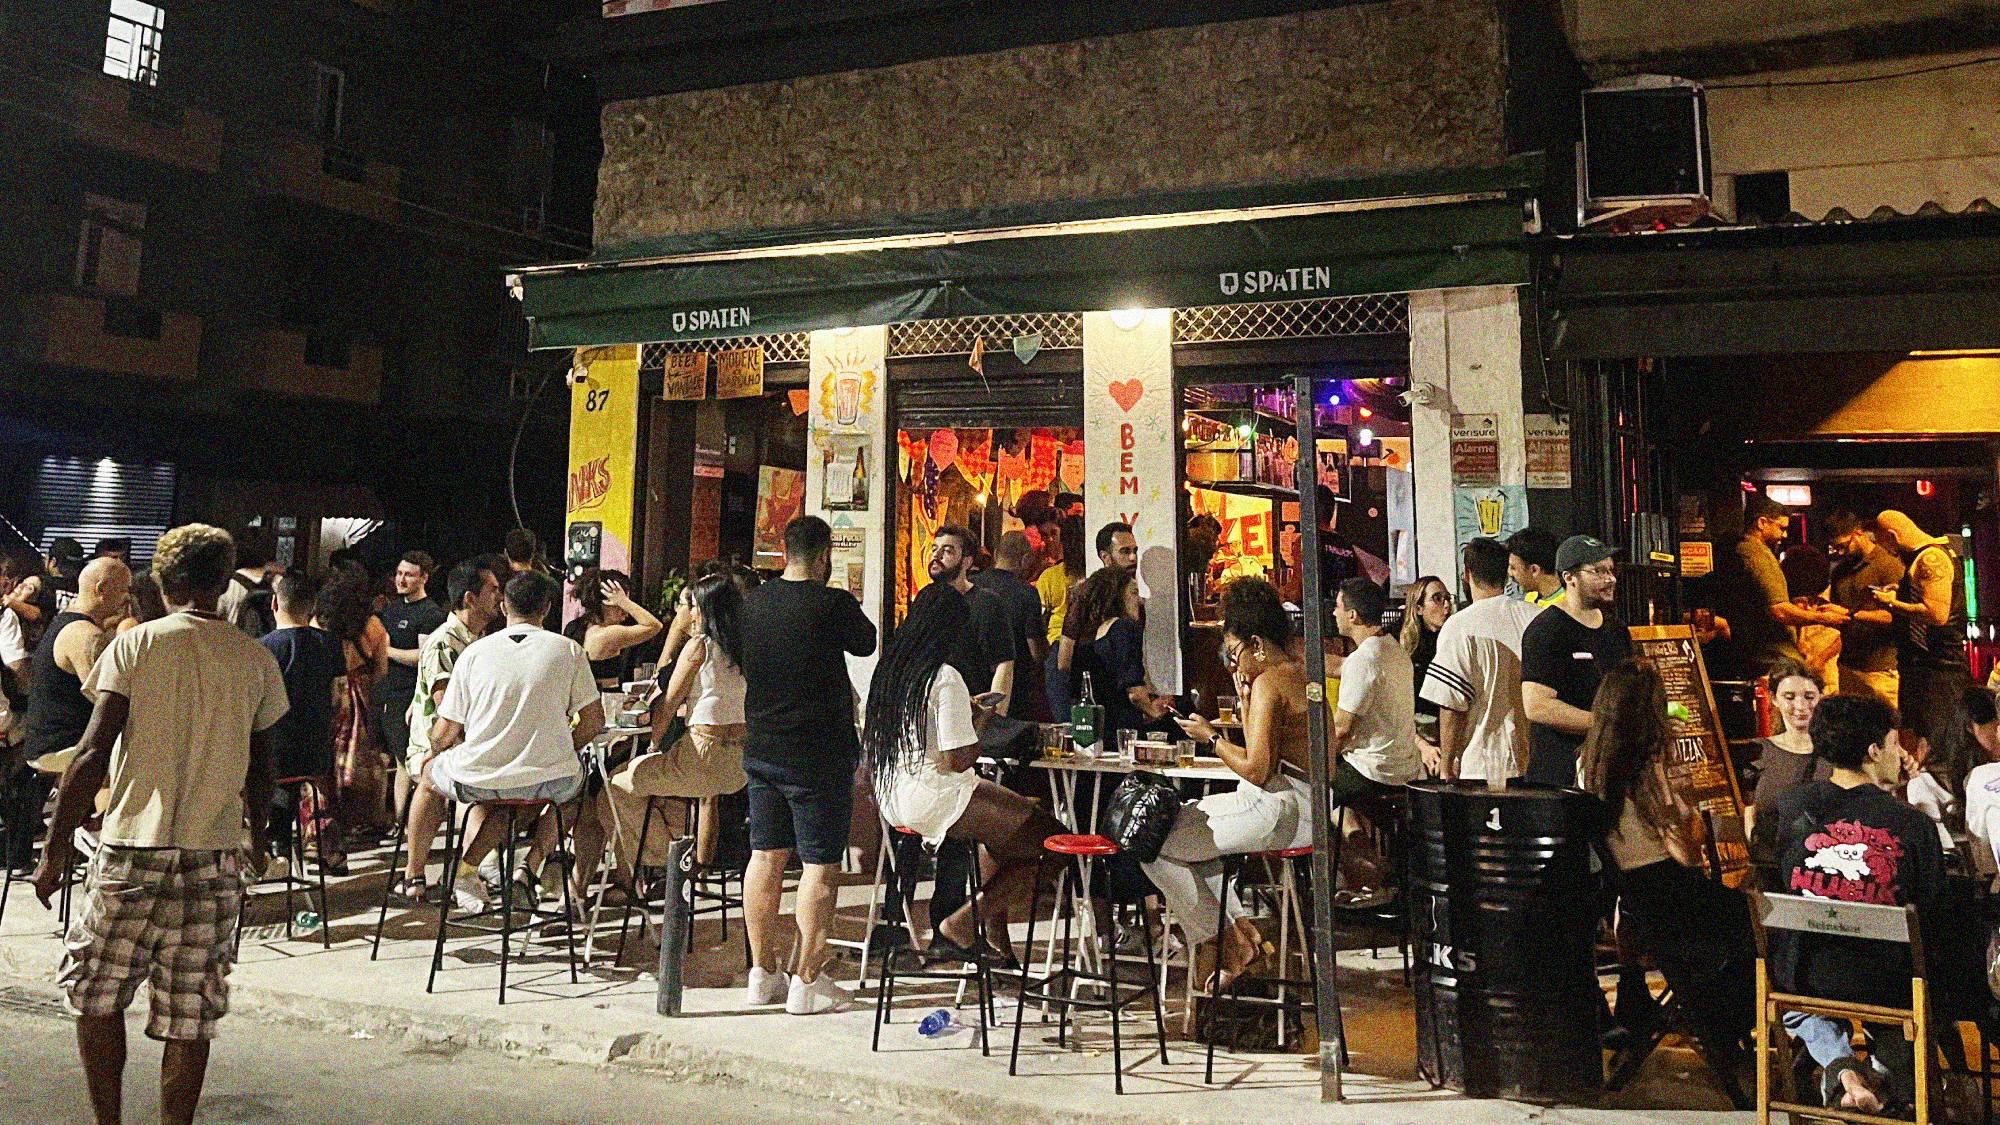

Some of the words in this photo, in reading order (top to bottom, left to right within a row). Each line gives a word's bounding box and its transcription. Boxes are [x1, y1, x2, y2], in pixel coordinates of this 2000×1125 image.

[1243, 266, 1330, 294] SPATEN
[689, 306, 750, 331] SPATEN
[586, 389, 610, 412] 87
[1453, 429, 1495, 437] verisure
[1455, 443, 1495, 453] Alarme
[1674, 736, 1708, 765] IZZAS
[1485, 807, 1503, 830] 1
